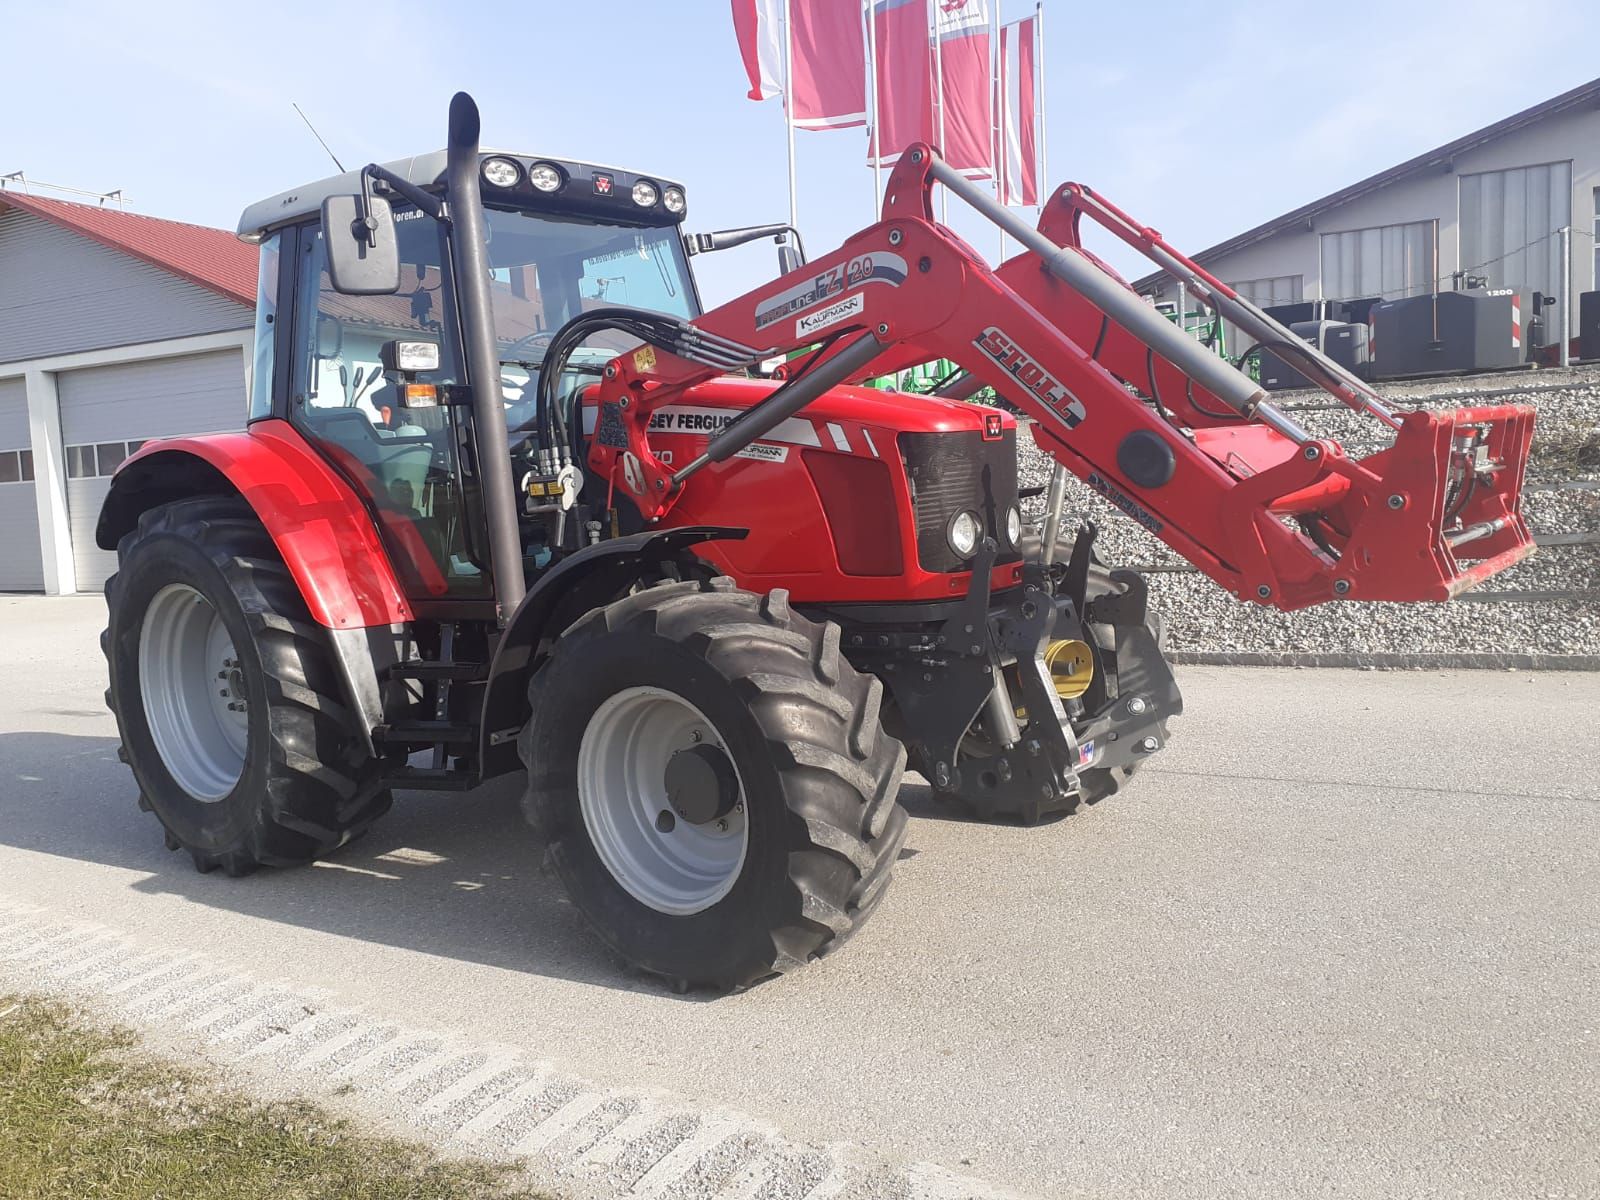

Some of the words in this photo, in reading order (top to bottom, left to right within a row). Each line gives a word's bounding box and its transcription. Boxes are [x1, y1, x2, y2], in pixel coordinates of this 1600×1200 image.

[851, 256, 873, 281] 20
[1486, 289, 1513, 297] 1200
[800, 301, 858, 330] KAUFMANN
[980, 331, 1075, 419] STOLL
